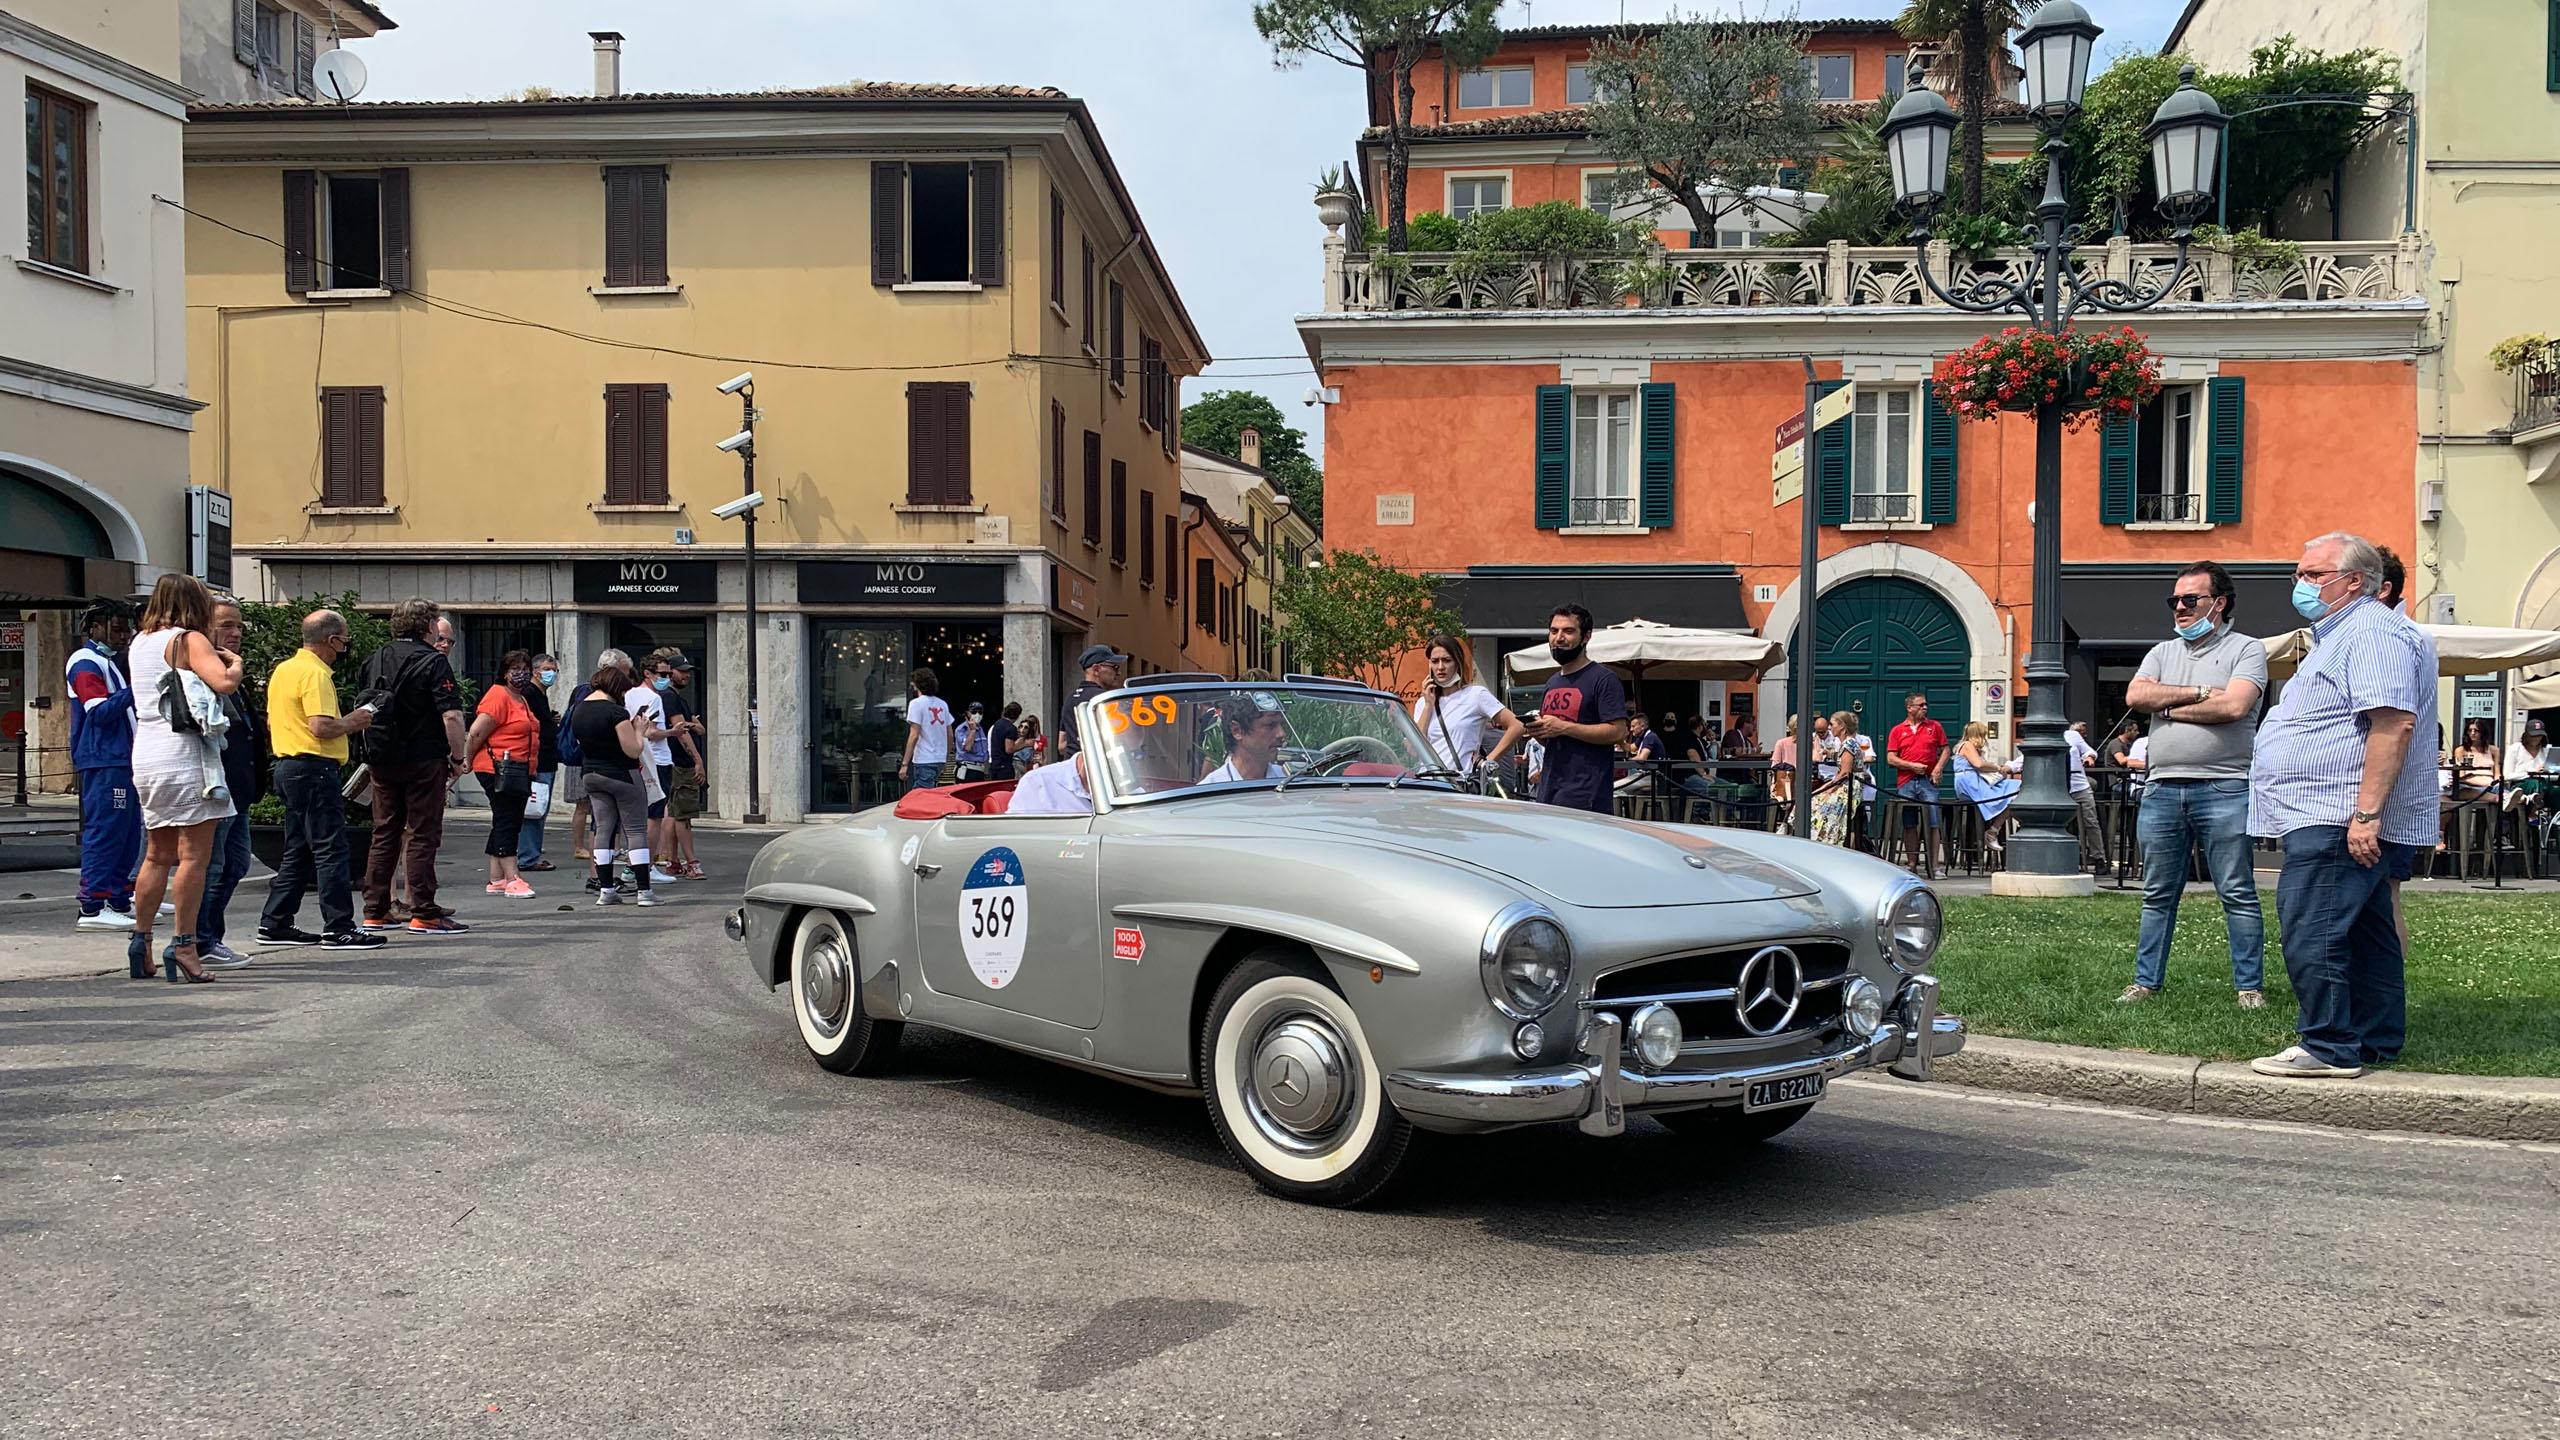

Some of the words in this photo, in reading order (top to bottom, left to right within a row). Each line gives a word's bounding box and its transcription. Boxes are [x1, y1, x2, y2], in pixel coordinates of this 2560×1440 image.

[620, 563, 668, 581] MYO
[876, 564, 925, 582] MYO
[608, 585, 642, 593] JAPANESE
[644, 585, 680, 593] COOKERY
[864, 585, 899, 594] JAPANESE
[901, 586, 937, 594] COOKERY
[1761, 587, 1770, 600] 11
[778, 620, 790, 632] 31
[1103, 695, 1177, 734] 369
[971, 895, 1015, 939] 369
[1117, 932, 1137, 943] 1000
[1116, 944, 1138, 957] MIGLIA
[1753, 1084, 1771, 1105] ZA
[1780, 1074, 1821, 1100] 622NK
